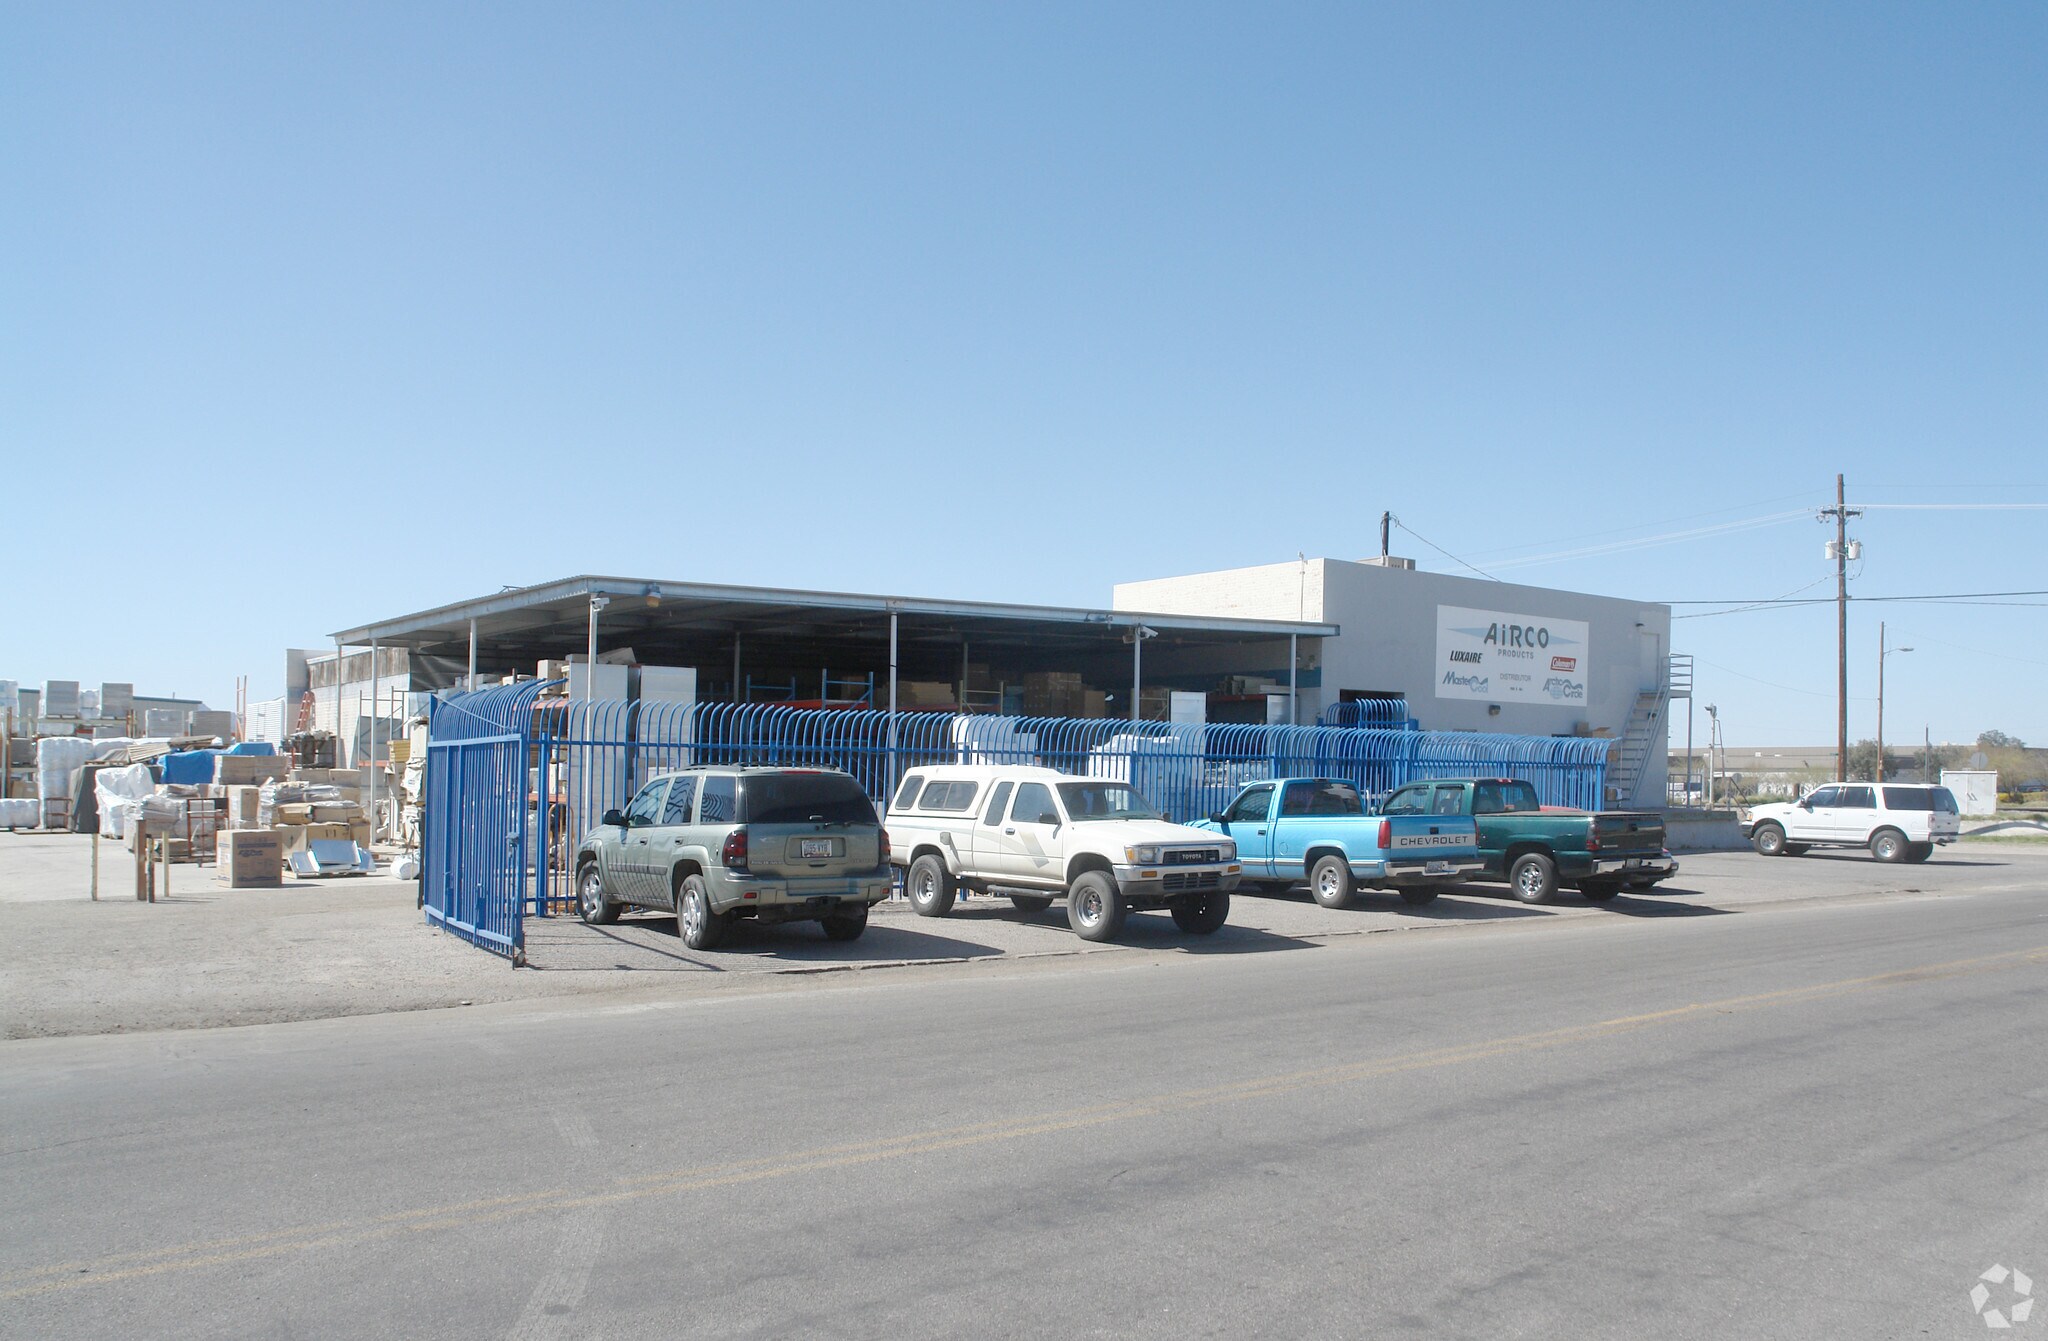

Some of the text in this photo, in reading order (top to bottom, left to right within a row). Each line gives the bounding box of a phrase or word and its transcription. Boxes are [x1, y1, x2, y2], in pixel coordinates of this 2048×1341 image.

[1450, 650, 1483, 664] LUXAIRE
[1498, 649, 1534, 660] PRODUCTS
[1400, 836, 1468, 846] CHEVROLET
